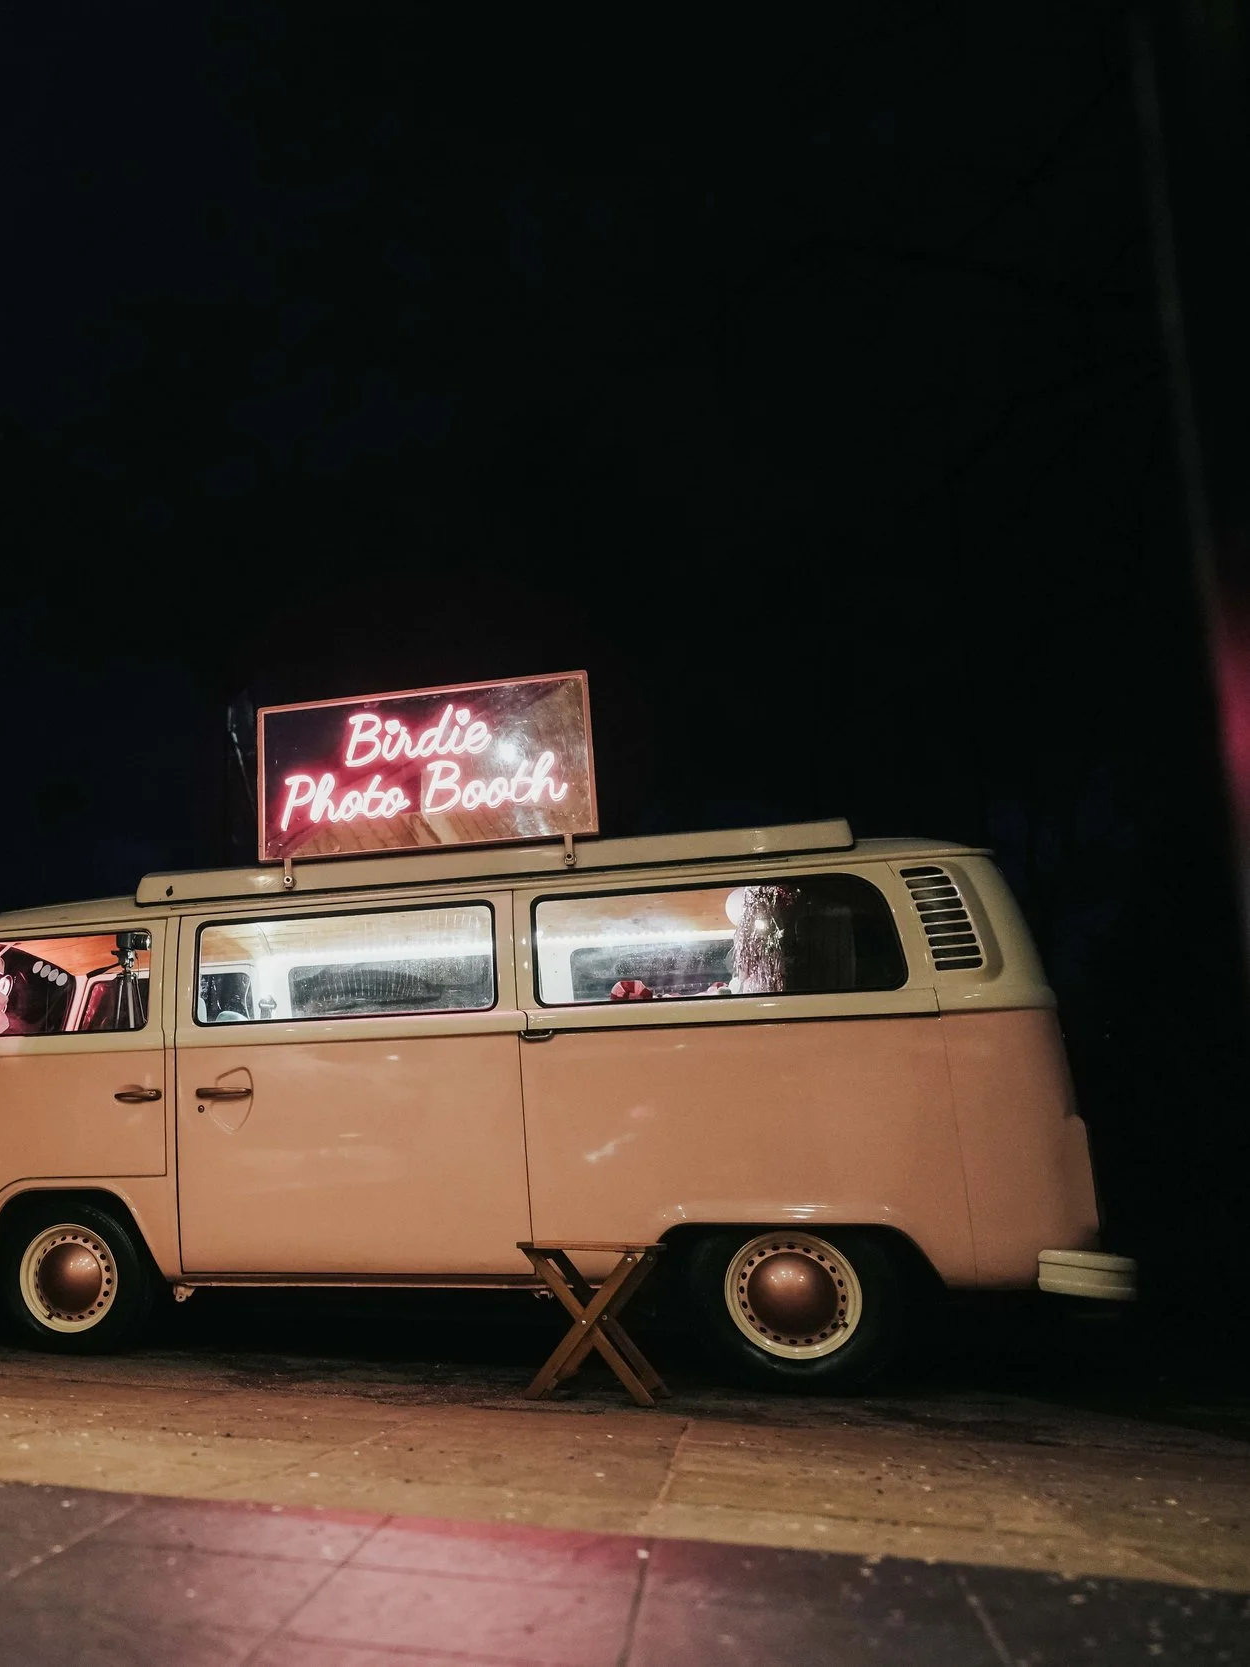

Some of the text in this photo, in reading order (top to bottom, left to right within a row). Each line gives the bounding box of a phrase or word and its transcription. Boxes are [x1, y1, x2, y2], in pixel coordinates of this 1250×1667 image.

[345, 704, 492, 767] Birdie
[280, 751, 568, 832] Photo Booth
